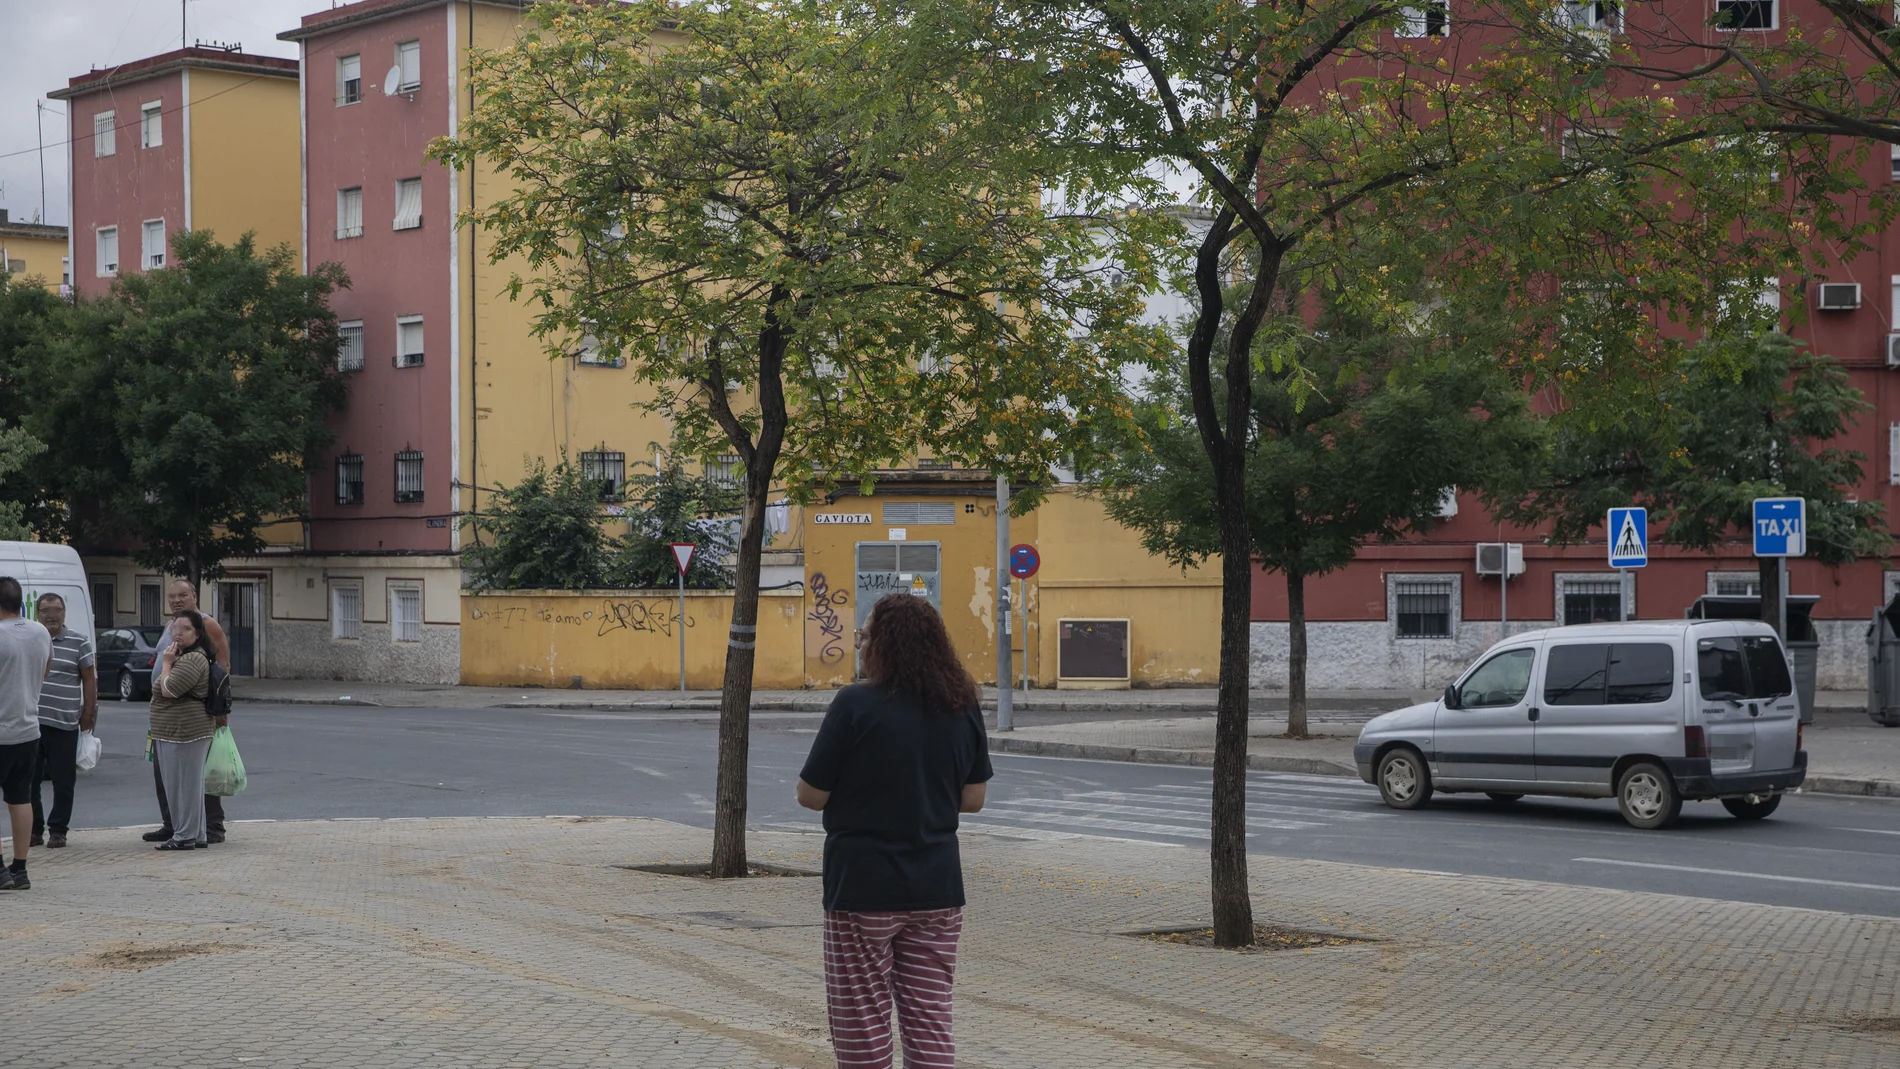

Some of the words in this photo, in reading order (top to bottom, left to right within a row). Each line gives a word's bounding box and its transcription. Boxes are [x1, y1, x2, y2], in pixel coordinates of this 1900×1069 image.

[815, 514, 871, 523] GAVIOTA
[1757, 518, 1799, 536] TAXI
[556, 614, 582, 625] amo
